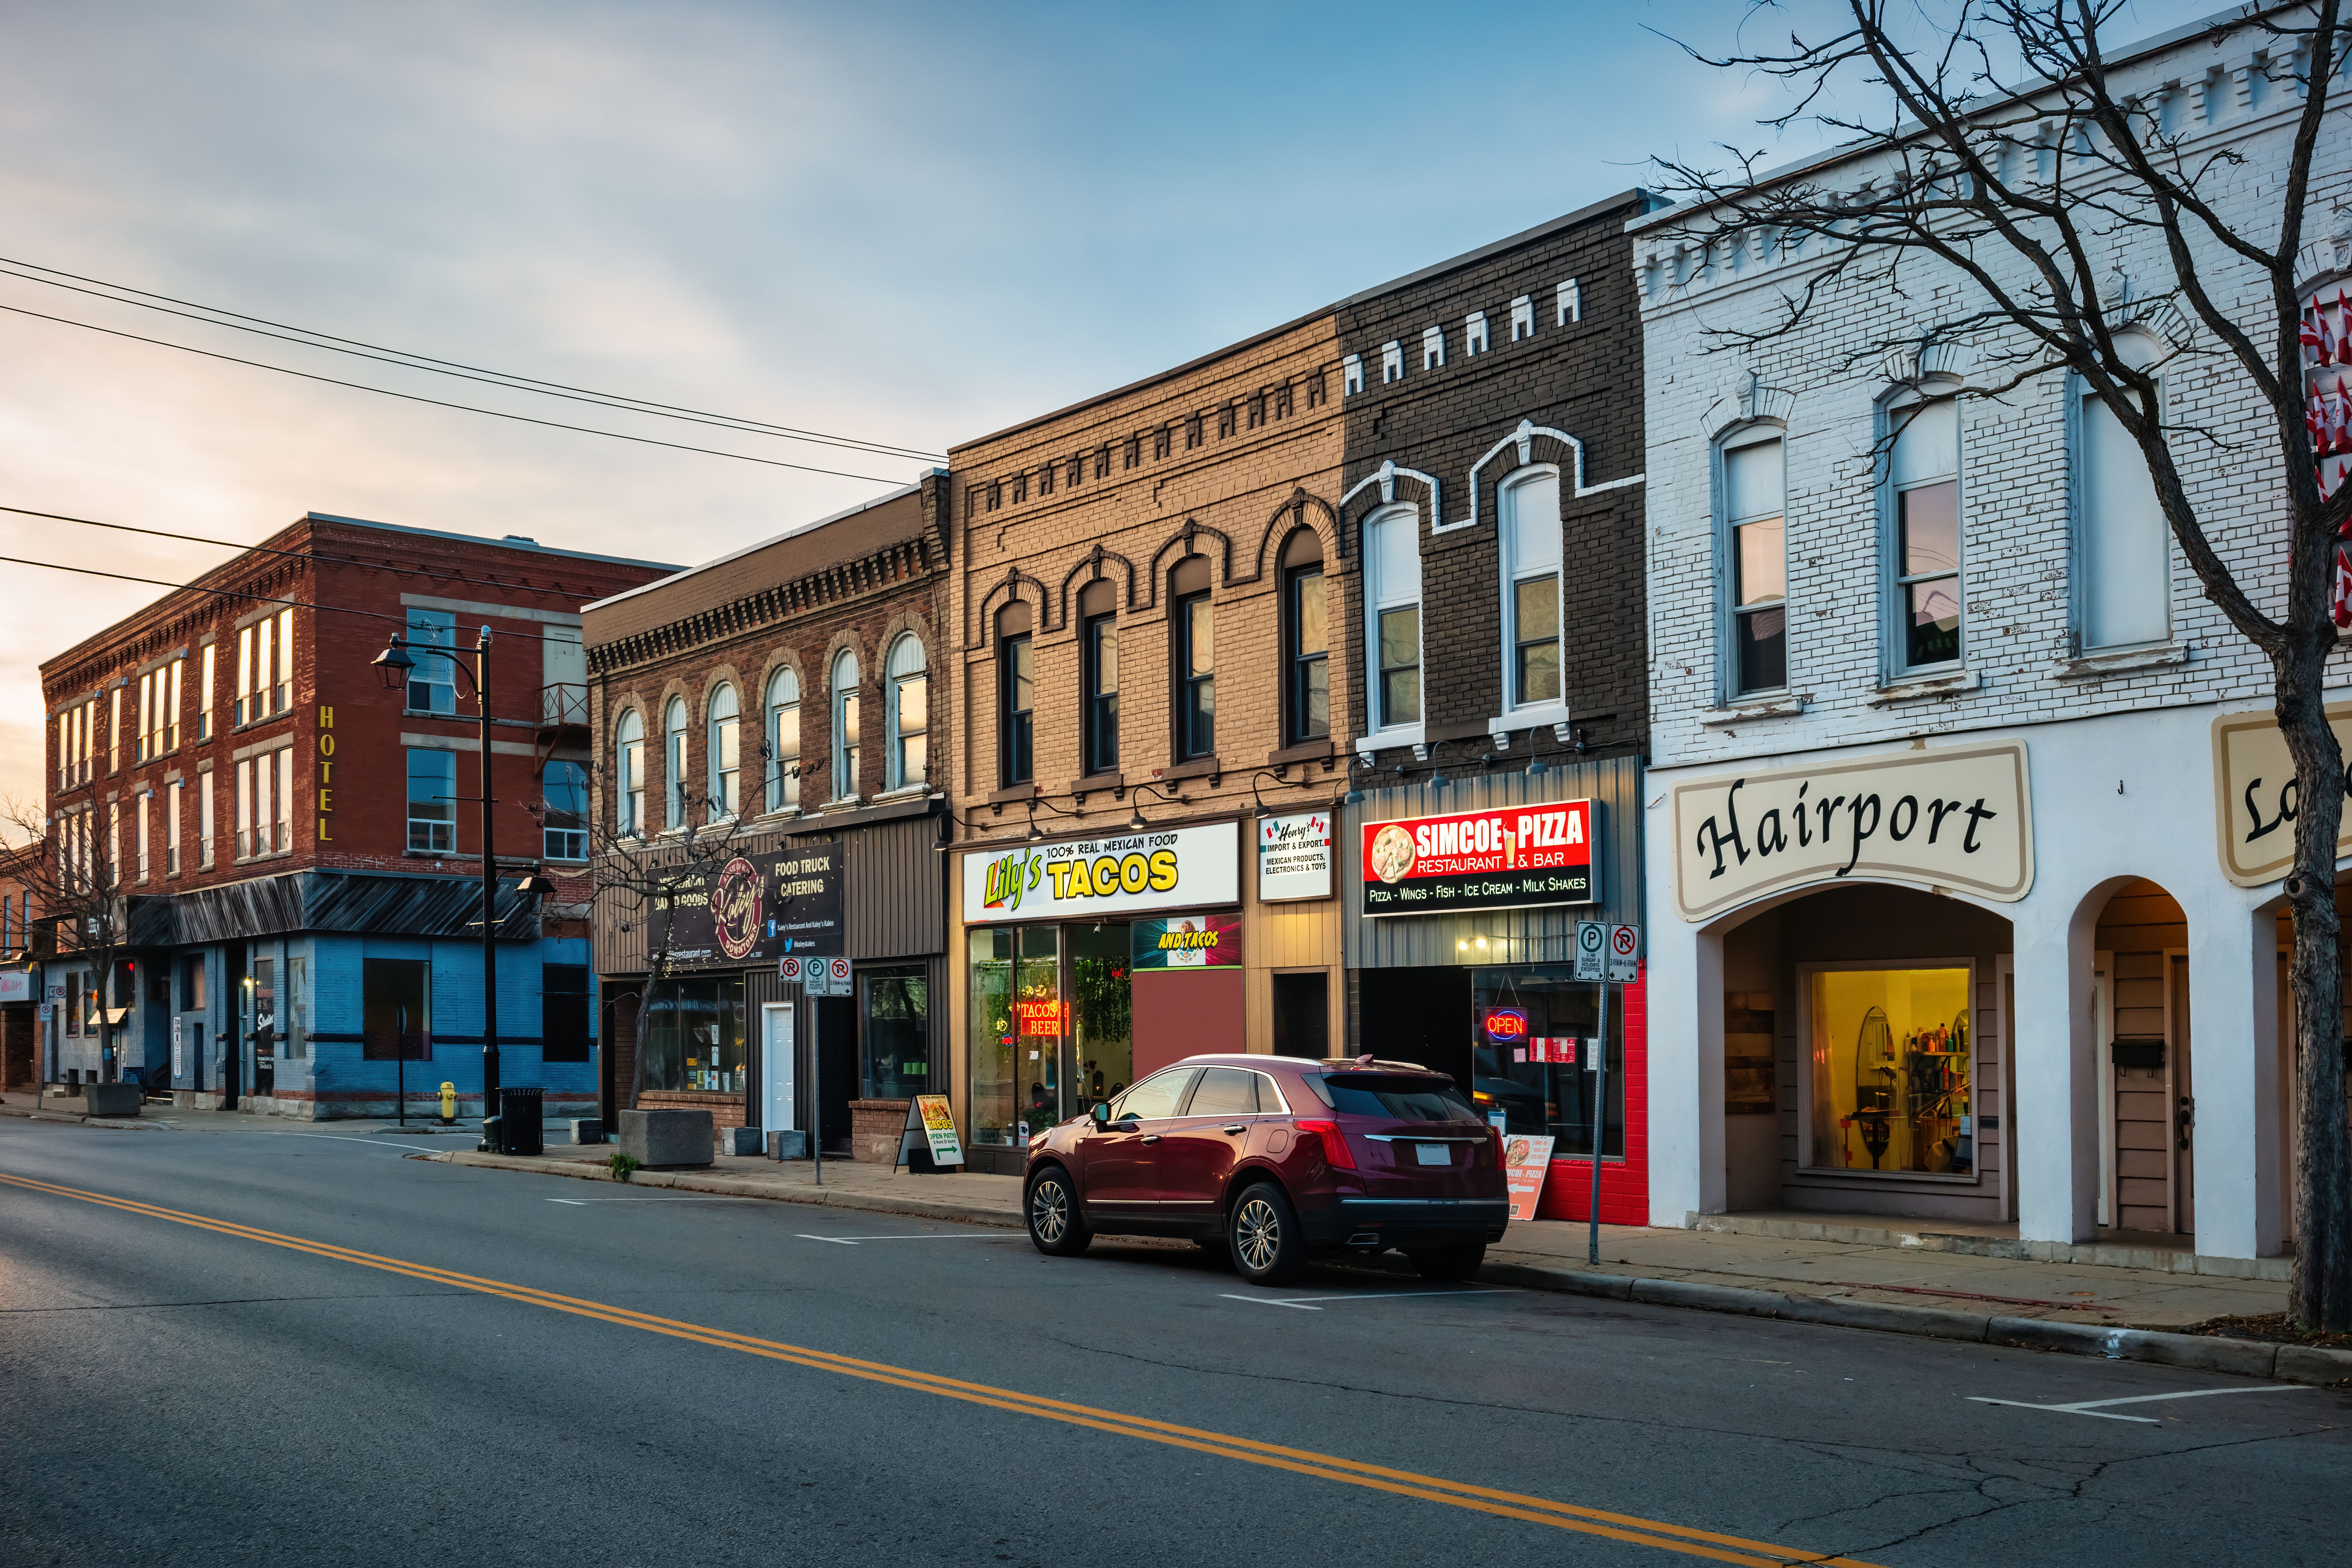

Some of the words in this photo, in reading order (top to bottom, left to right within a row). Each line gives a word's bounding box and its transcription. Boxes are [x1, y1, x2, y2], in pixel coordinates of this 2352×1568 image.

[320, 706, 335, 841] HOTEL
[1278, 822, 1311, 841] Henry's
[1416, 818, 1503, 858] SIMCOE
[1518, 810, 1584, 849] PIZZA
[1696, 778, 1998, 879] Hairport
[1047, 844, 1074, 858] 100%
[1078, 841, 1100, 855] REAL
[1104, 837, 1144, 852] MEXICAN
[1149, 834, 1178, 847] FOOD
[1267, 843, 1290, 852] IMPORT
[1298, 839, 1323, 849] EXPORT
[775, 861, 799, 877] FOOD
[800, 856, 830, 873] TRUCK
[1267, 857, 1291, 865] MEXICAN
[1293, 853, 1325, 863] PRODUCTS,
[1418, 856, 1503, 873] RESTAURANT
[1518, 854, 1528, 867] &
[1534, 852, 1564, 866] BAR
[984, 847, 1042, 910] Lily's
[1047, 849, 1179, 900] TACOS
[1266, 865, 1304, 874] ELECTRONICS
[781, 879, 824, 897] CATERING
[681, 892, 708, 907] GOODS
[726, 923, 757, 955] DOWNTOWN
[1158, 932, 1182, 951] AND
[1183, 929, 1219, 951] TACOS
[1021, 1004, 1056, 1017] TACOS
[1030, 1021, 1058, 1034] BEER
[1488, 1017, 1522, 1033] OPEN
[925, 1107, 940, 1119] Lily's
[926, 1119, 953, 1130] TACOS
[1507, 1169, 1523, 1177] MCOE
[1526, 1170, 1542, 1179] PIZZA
